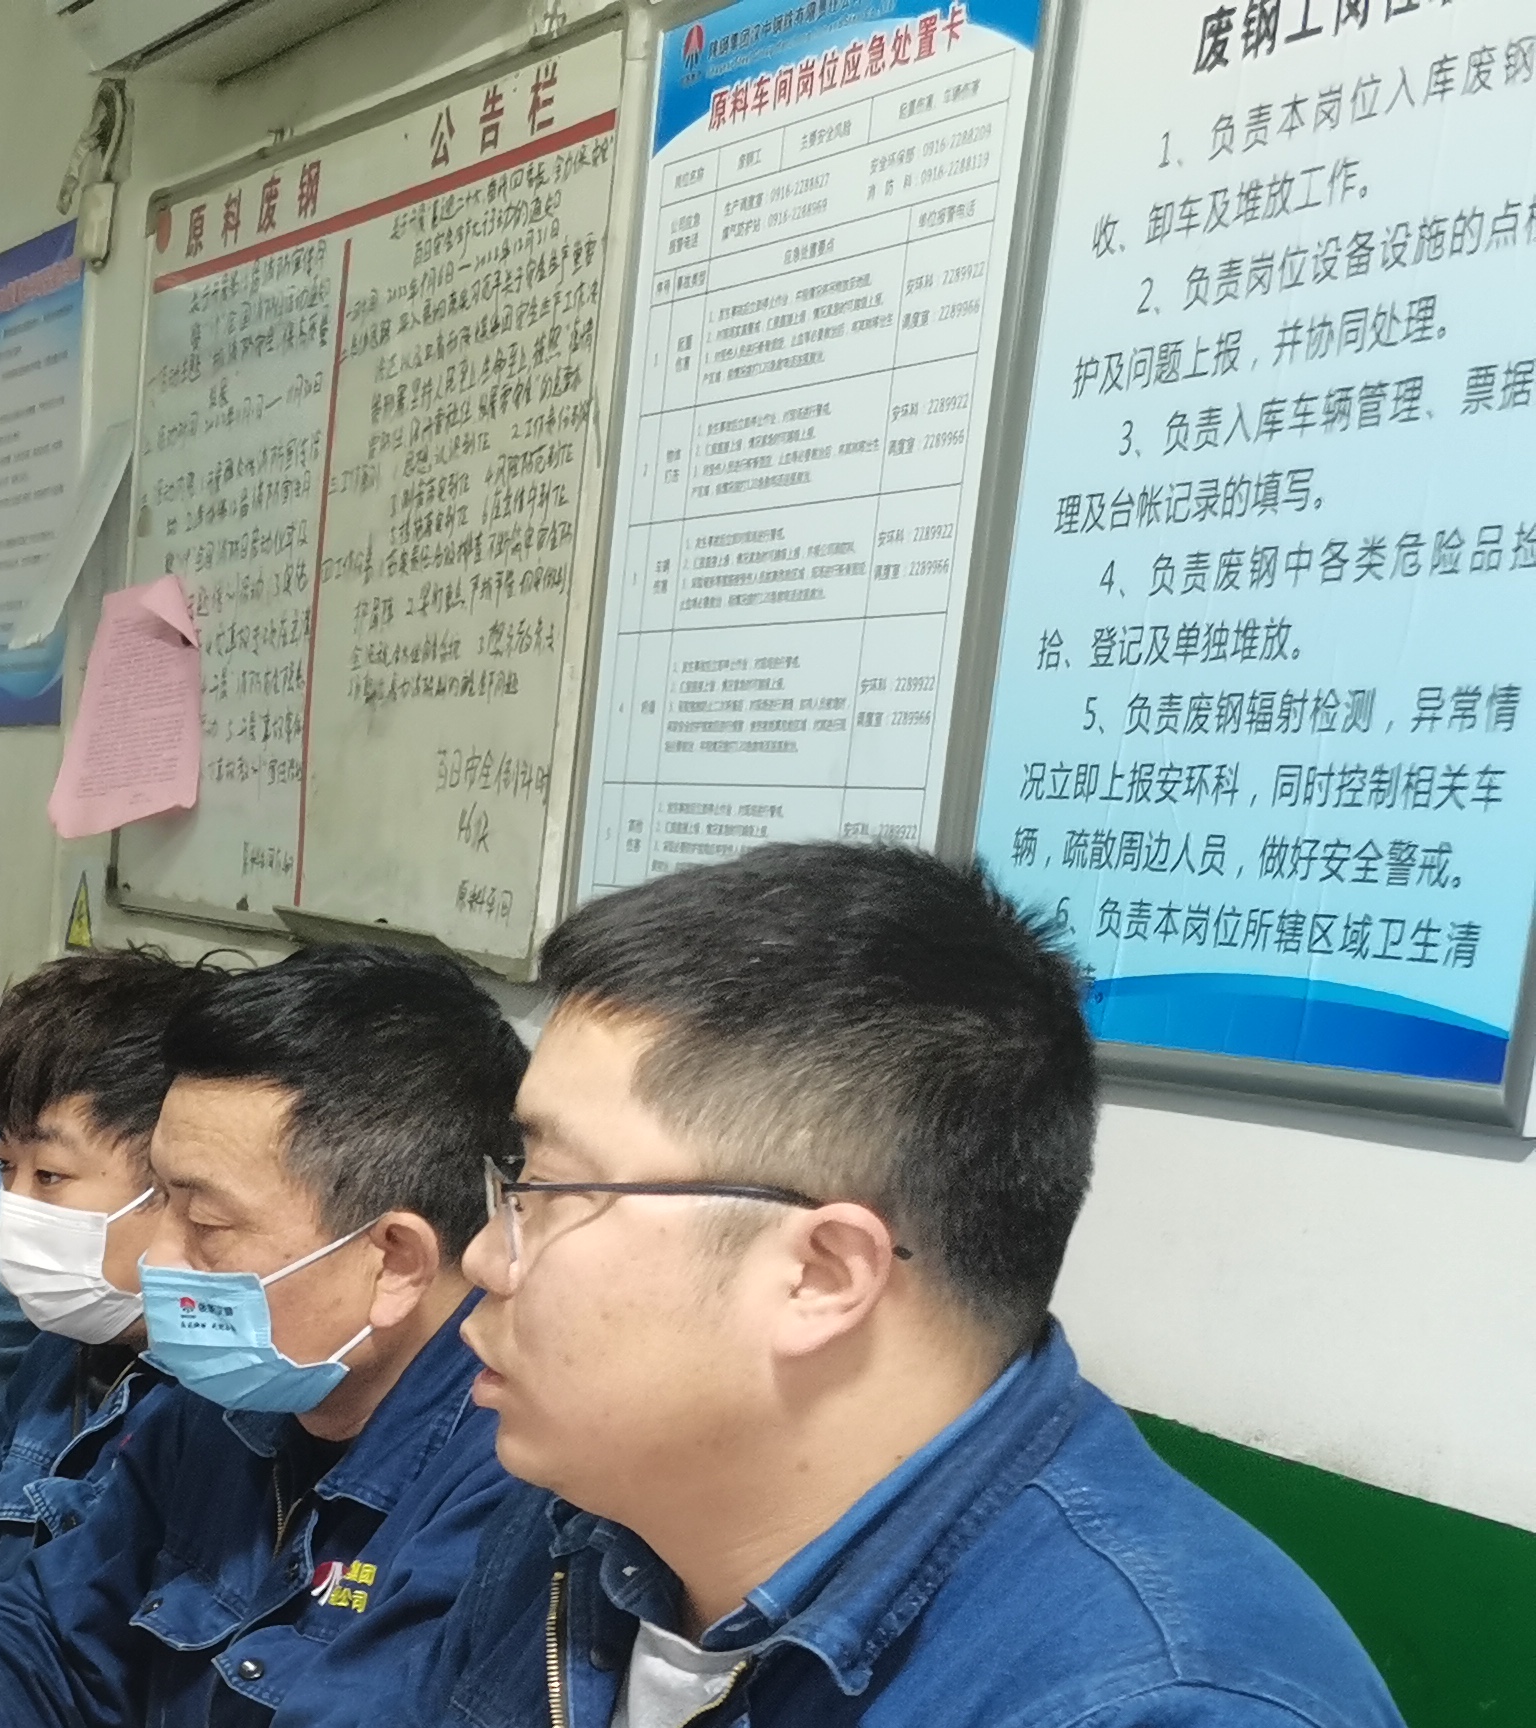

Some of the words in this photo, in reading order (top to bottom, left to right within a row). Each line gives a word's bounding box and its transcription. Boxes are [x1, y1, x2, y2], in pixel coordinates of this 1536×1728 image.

[707, 4, 966, 132] 原料车间岗位应急处置卡
[430, 61, 560, 169] 公告栏
[185, 159, 322, 259] 原料废钢
[1091, 157, 1370, 259] 收、卸车及堆放工作。
[1071, 293, 1448, 400] 护及问题上报，并协同处理。
[1054, 467, 1325, 536] 理及台帐记录的填写。
[1037, 617, 1302, 671] 拾、登记及单独堆放。
[1083, 682, 1523, 737] 5、负责废钢辐射检测，异常情
[1018, 761, 1508, 814] 况立即上报安环科，同时控制相关车
[1011, 826, 1466, 891] 辆，疏散周边人员，做好安全警戒。
